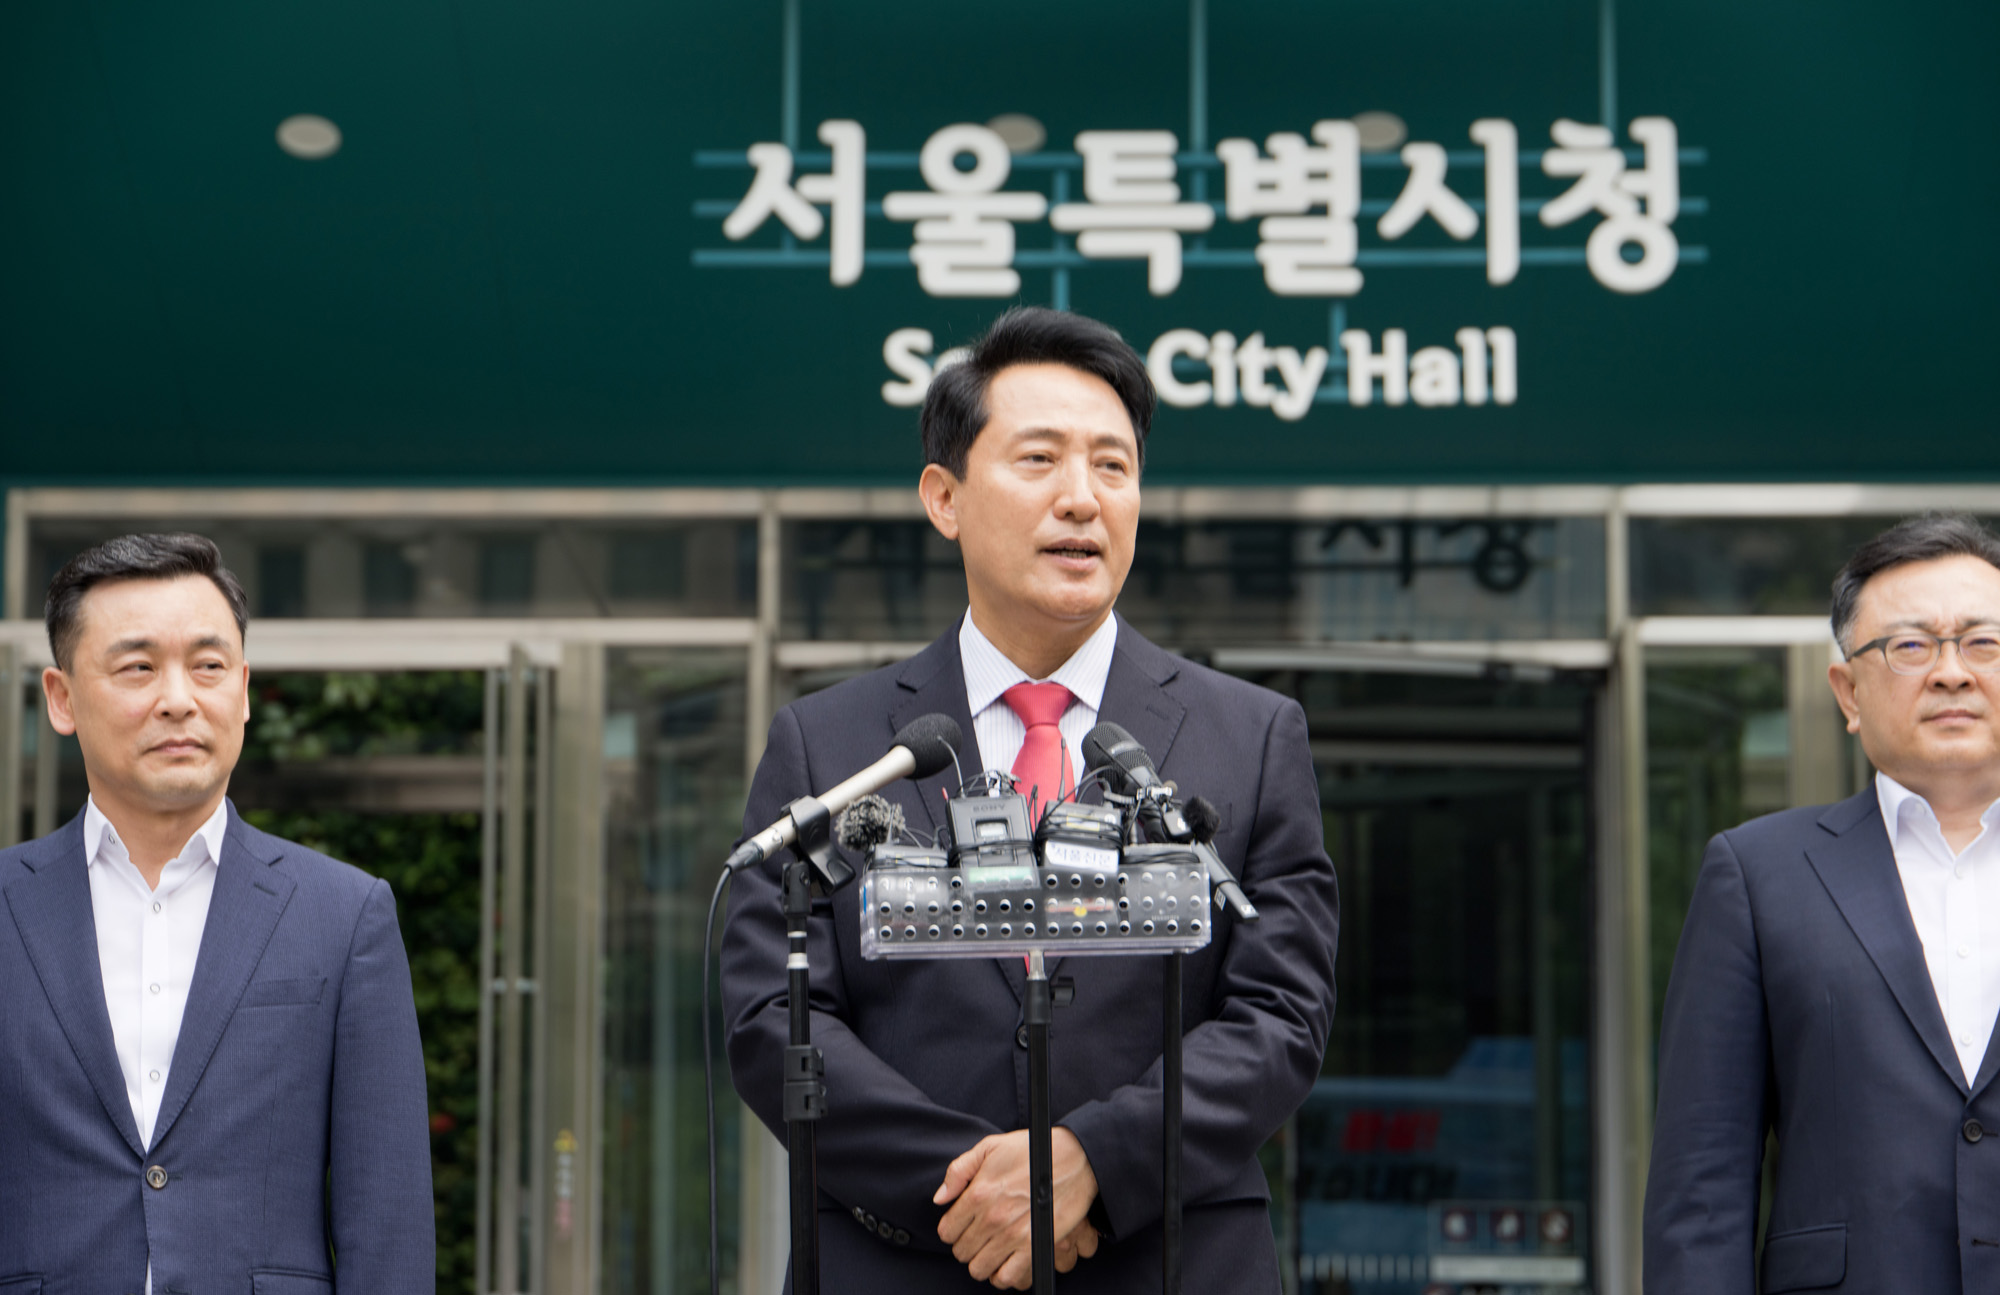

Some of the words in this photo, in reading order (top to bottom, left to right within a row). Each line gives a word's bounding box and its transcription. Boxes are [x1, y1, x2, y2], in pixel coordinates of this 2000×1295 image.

[722, 117, 1680, 297] 서울특별시청
[1147, 327, 1329, 420] City
[1339, 326, 1518, 407] Hall
[972, 803, 1006, 813] SONY
